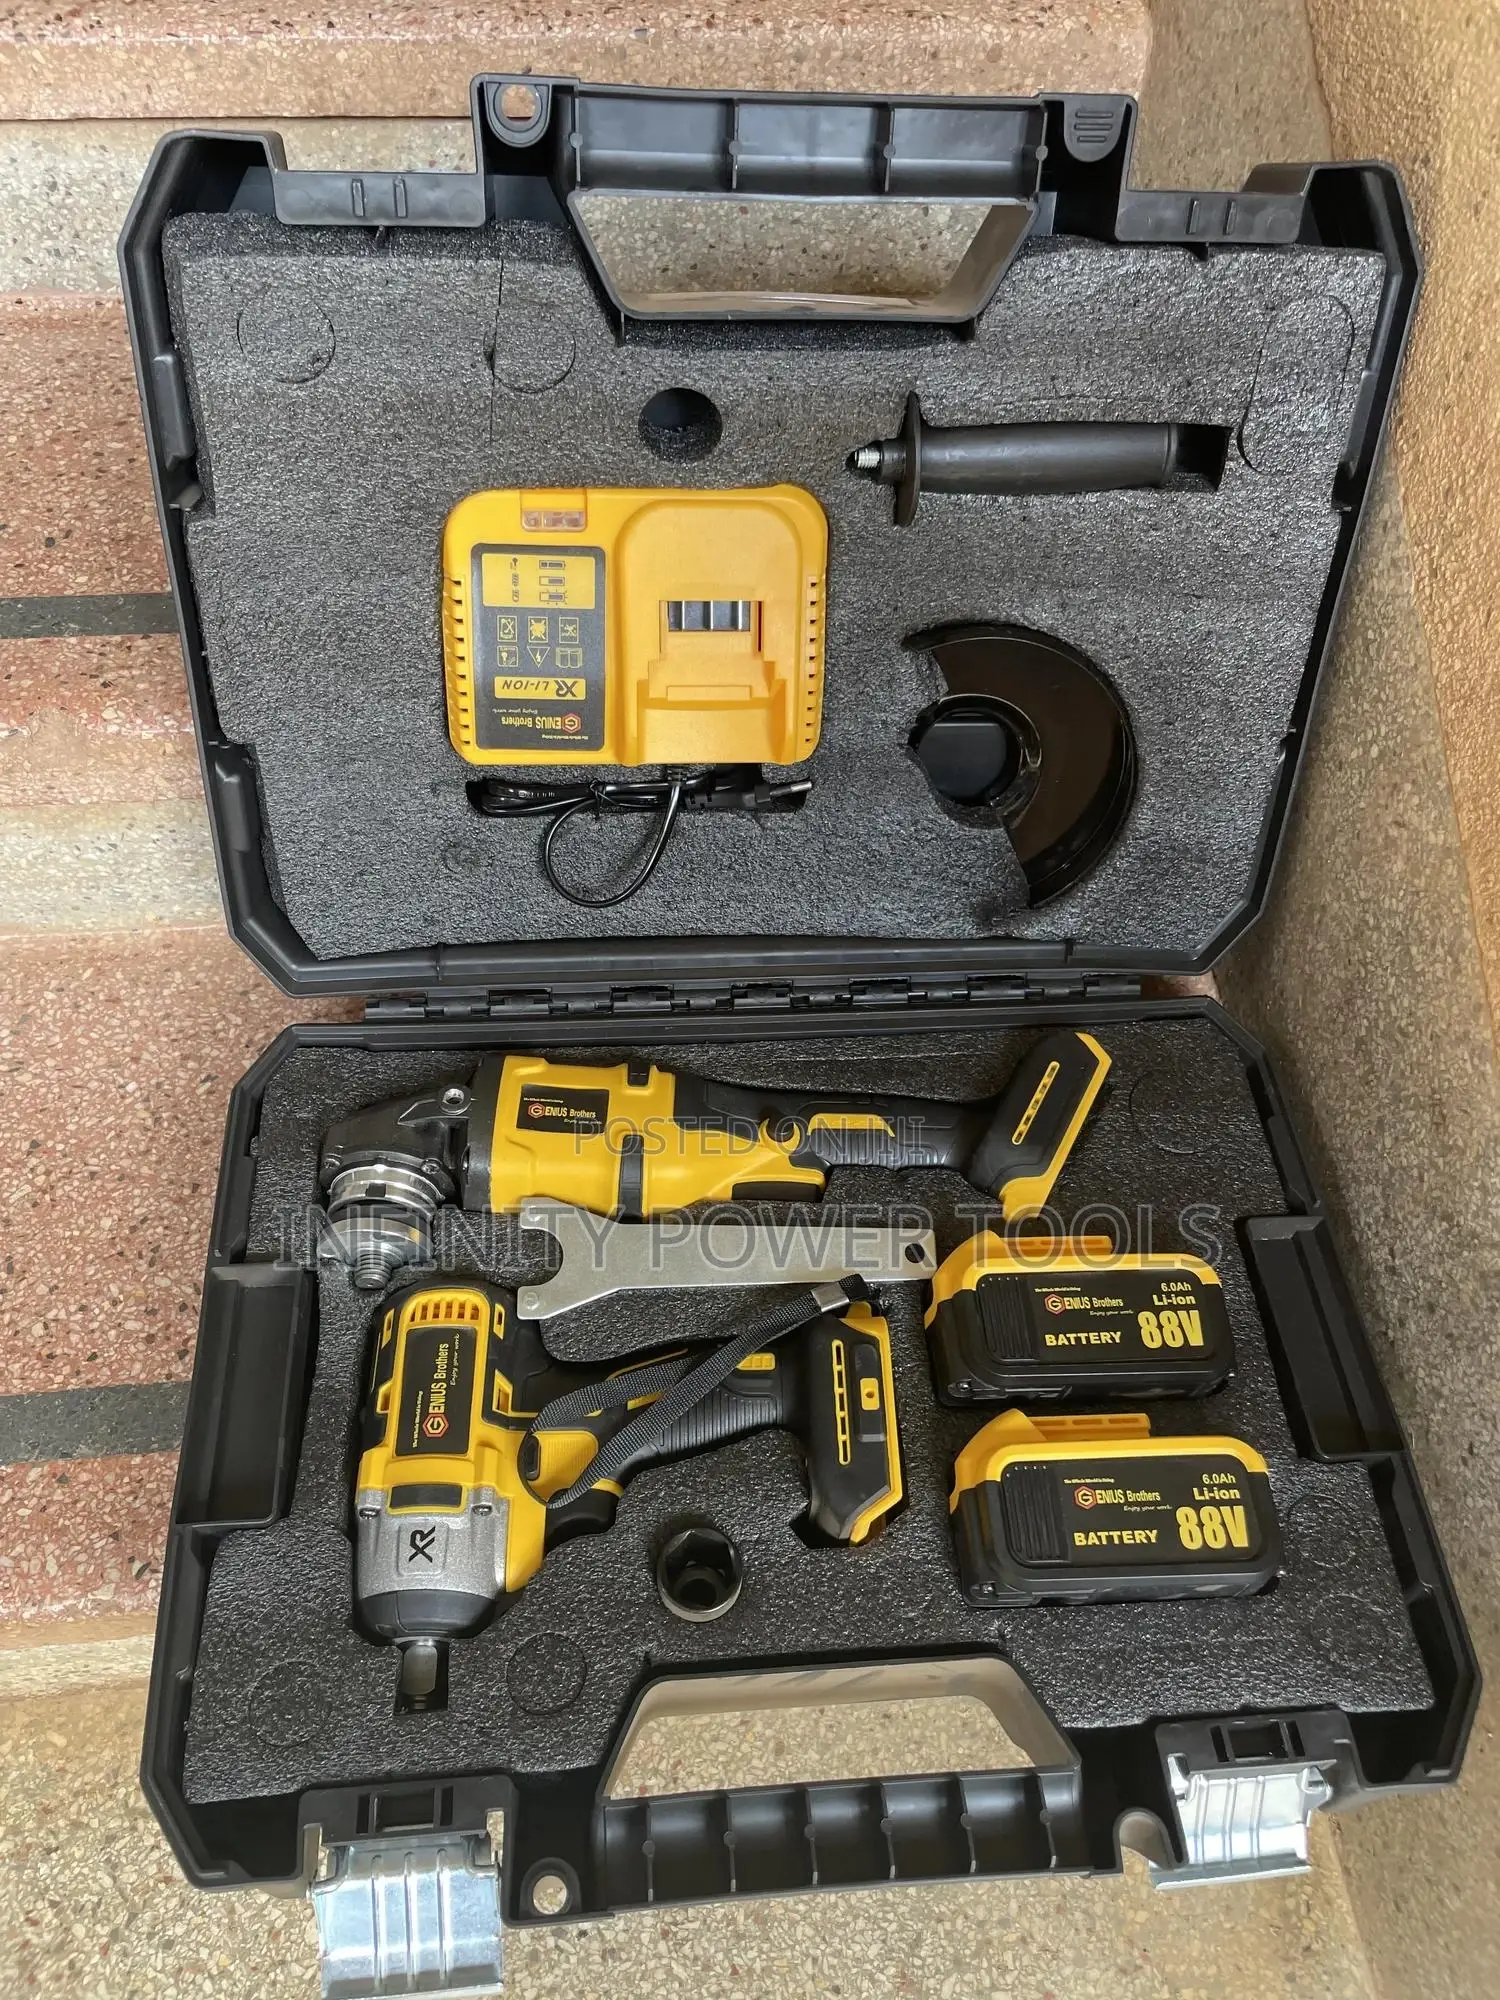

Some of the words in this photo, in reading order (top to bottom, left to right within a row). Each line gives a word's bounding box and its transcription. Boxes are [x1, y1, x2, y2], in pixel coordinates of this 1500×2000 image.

[502, 680, 549, 691] LI-ION
[554, 680, 578, 697] XR
[501, 716, 532, 728] Brothers
[569, 1108, 596, 1118] Brothers
[1160, 1282, 1191, 1292] 6.0Ah
[1093, 1297, 1124, 1308] Brothers
[1152, 1294, 1196, 1306] Li-ion
[1137, 1310, 1205, 1349] 88V
[1045, 1331, 1122, 1346] BATTERY
[434, 1343, 449, 1379] Brothers
[1202, 1473, 1236, 1484] 6.0Ah
[1127, 1490, 1161, 1502] Brothers
[1192, 1487, 1241, 1500] Li-ion
[1176, 1505, 1249, 1550] 88V
[1073, 1529, 1158, 1546] BATTERY
